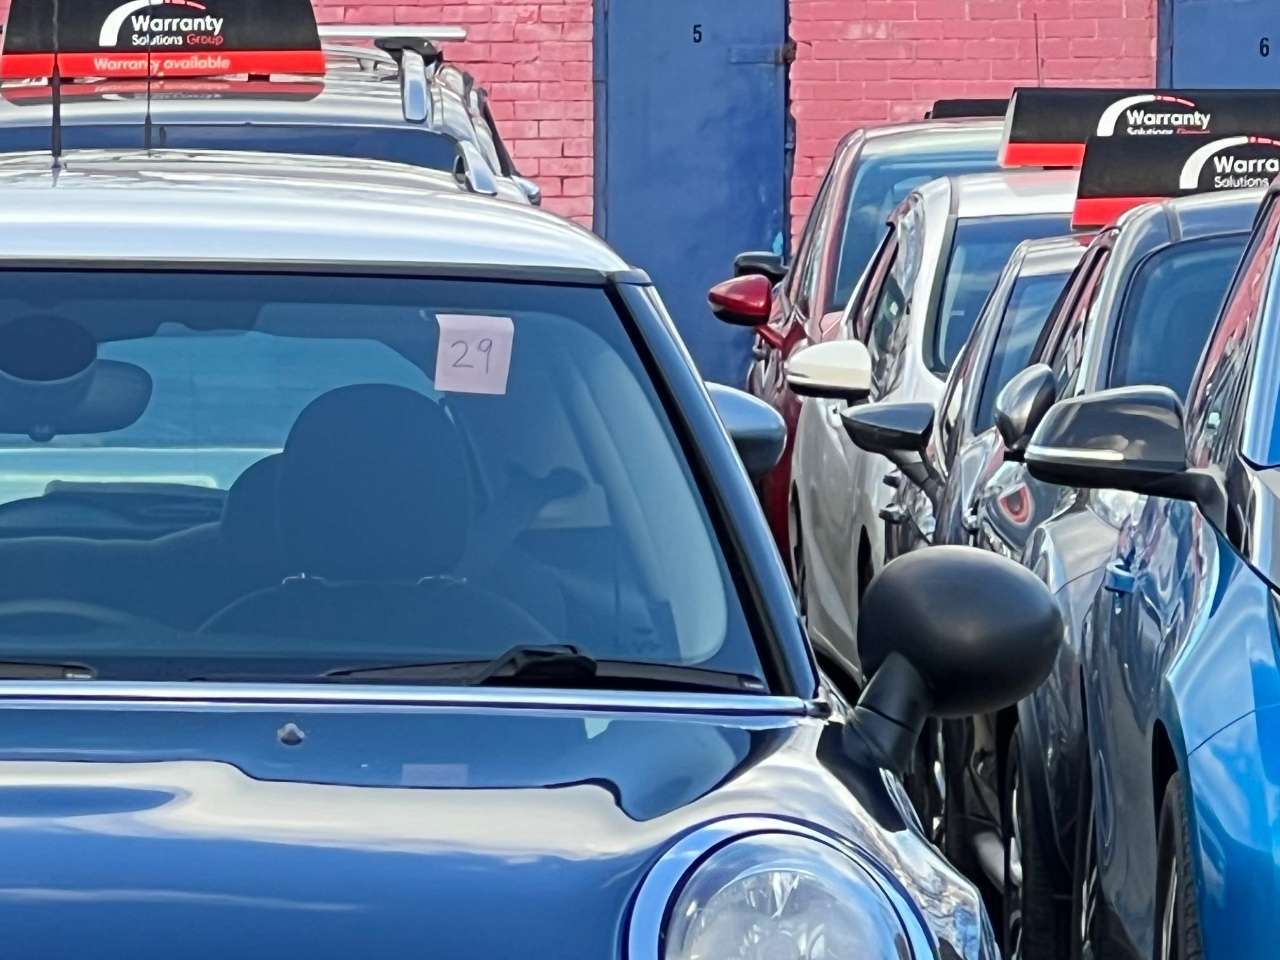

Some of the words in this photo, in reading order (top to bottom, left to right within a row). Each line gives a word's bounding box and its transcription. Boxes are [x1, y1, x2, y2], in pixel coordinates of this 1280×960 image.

[131, 14, 223, 36] Warranty
[693, 24, 702, 43] 5
[131, 33, 183, 46] Solutions
[186, 33, 224, 46] Group
[1259, 37, 1269, 57] 6
[163, 57, 231, 70] available
[1126, 109, 1211, 130] Warranty
[1214, 175, 1270, 189] Solutions
[450, 337, 493, 375] 29
